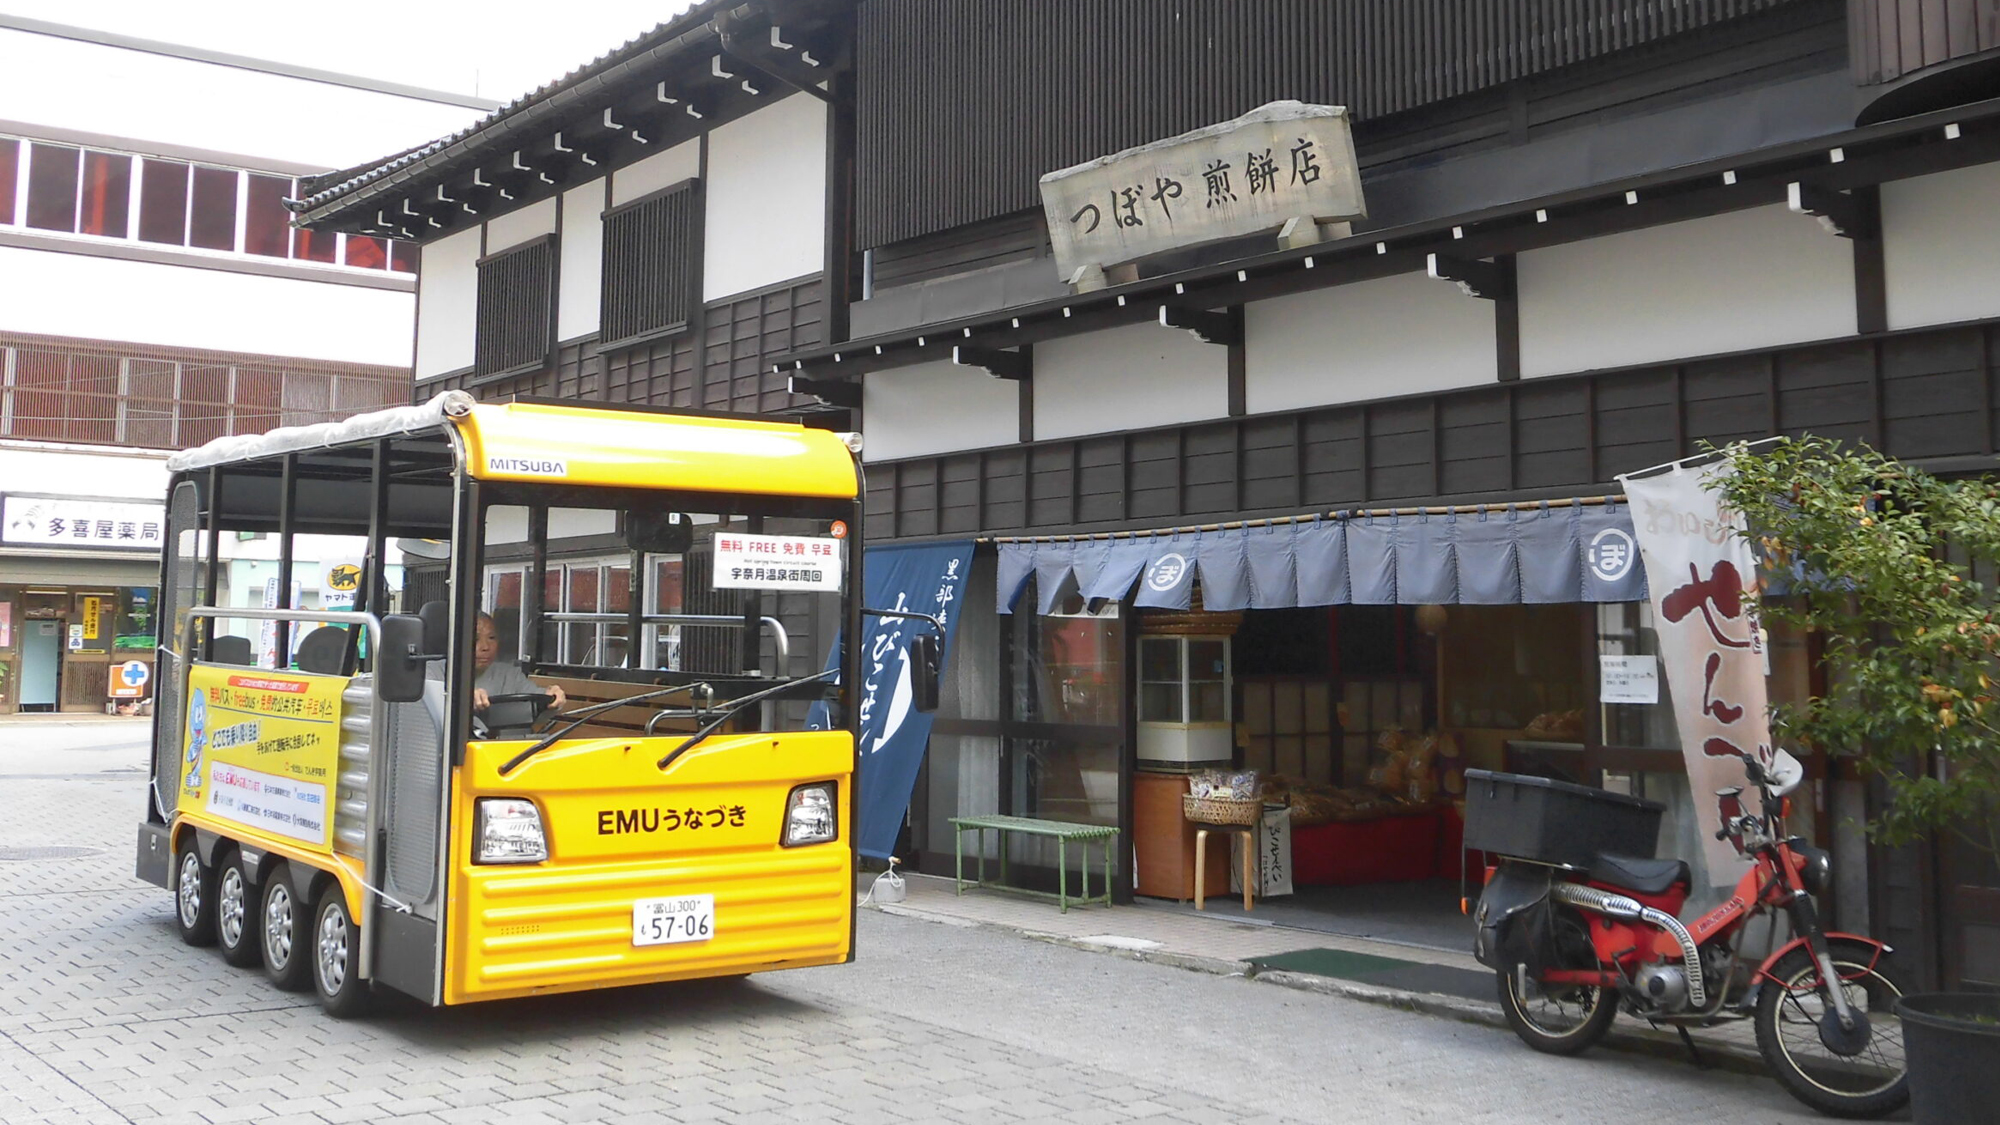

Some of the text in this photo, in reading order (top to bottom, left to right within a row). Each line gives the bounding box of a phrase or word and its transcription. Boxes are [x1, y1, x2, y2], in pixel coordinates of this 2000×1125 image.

[1070, 138, 1320, 234] つぼや煎餅店
[490, 458, 564, 474] MITSUBA
[48, 517, 160, 542] 多喜屋薬局
[720, 540, 743, 553] 無料
[749, 541, 777, 554] FREE
[812, 544, 832, 556] 무료
[731, 567, 823, 583] 宇奈月温泉街周回
[597, 805, 747, 836] EMUうなづき
[652, 914, 709, 940] 57-06
